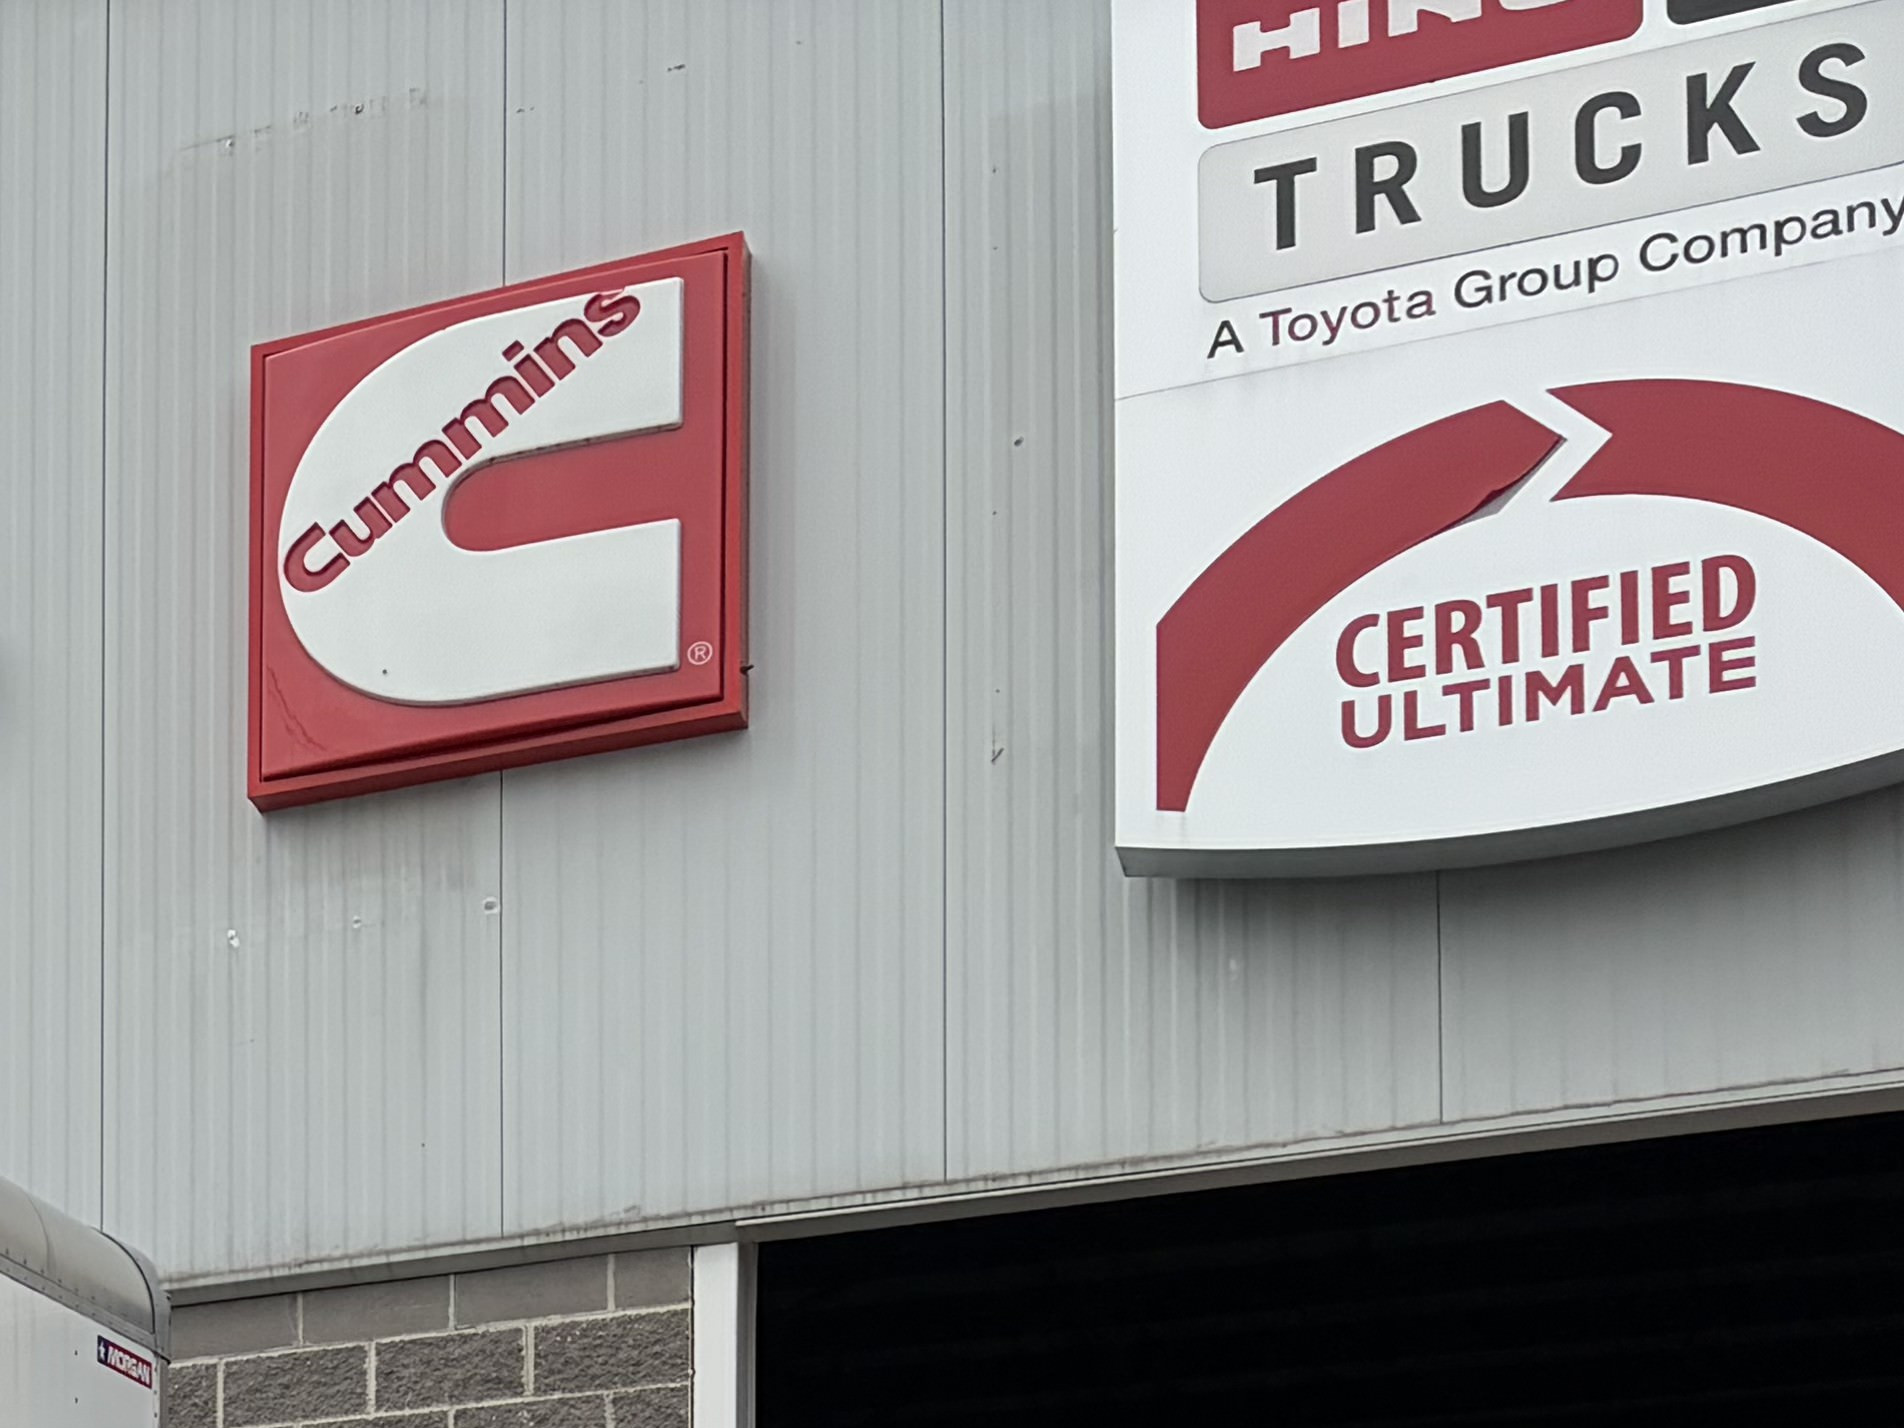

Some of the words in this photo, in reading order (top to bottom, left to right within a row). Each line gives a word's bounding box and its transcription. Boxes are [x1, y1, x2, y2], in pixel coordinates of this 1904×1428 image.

[1233, 0, 1564, 72] HIN
[1254, 42, 1868, 251] TRUCKS
[1207, 320, 1245, 359] A
[1260, 288, 1436, 347] Toyota
[1453, 246, 1620, 309] Group
[1639, 197, 1904, 273] Company
[283, 289, 641, 593] Cummins
[1335, 553, 1758, 689] CERTIFIED
[1339, 636, 1757, 749] ULTIMATE
[107, 1346, 150, 1385] MORGAN
